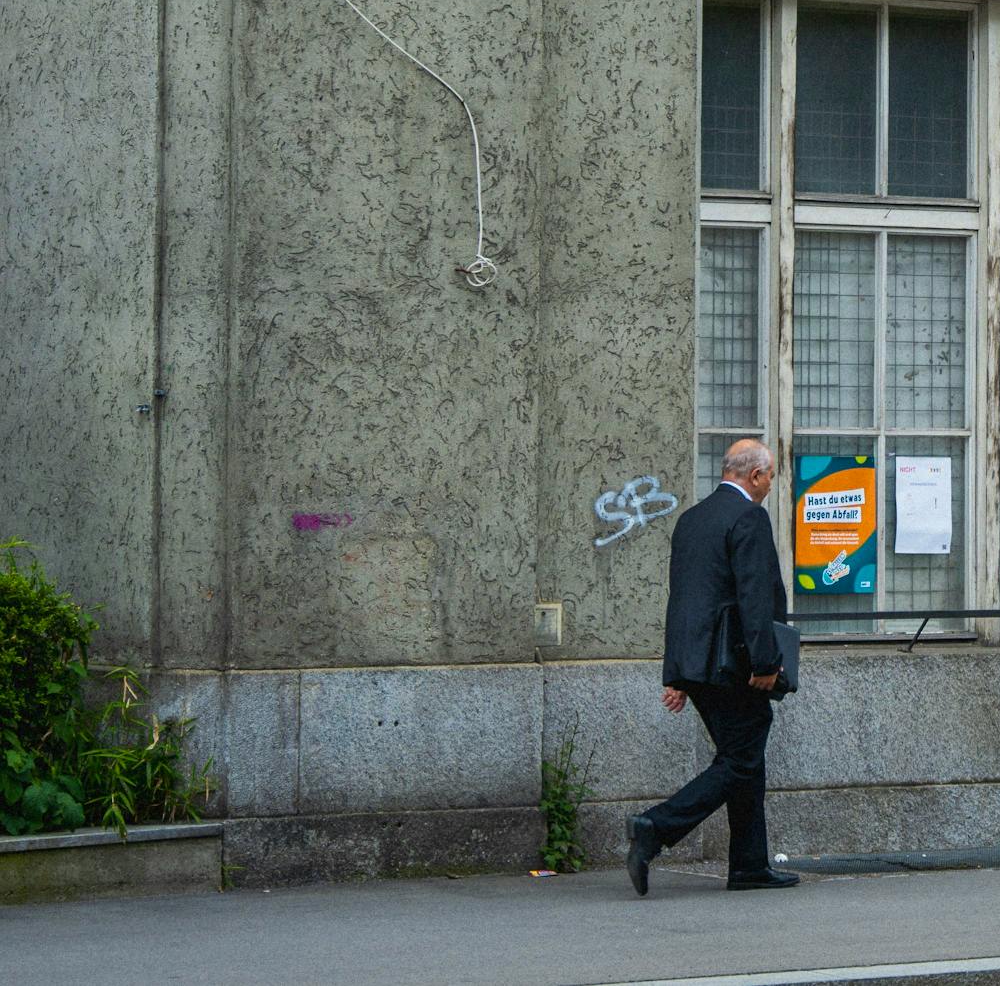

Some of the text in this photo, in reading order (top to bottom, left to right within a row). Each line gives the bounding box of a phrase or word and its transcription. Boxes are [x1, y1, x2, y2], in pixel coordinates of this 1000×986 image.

[808, 494, 862, 506] Hast du etwas
[806, 510, 859, 521] gegen Abfall?
